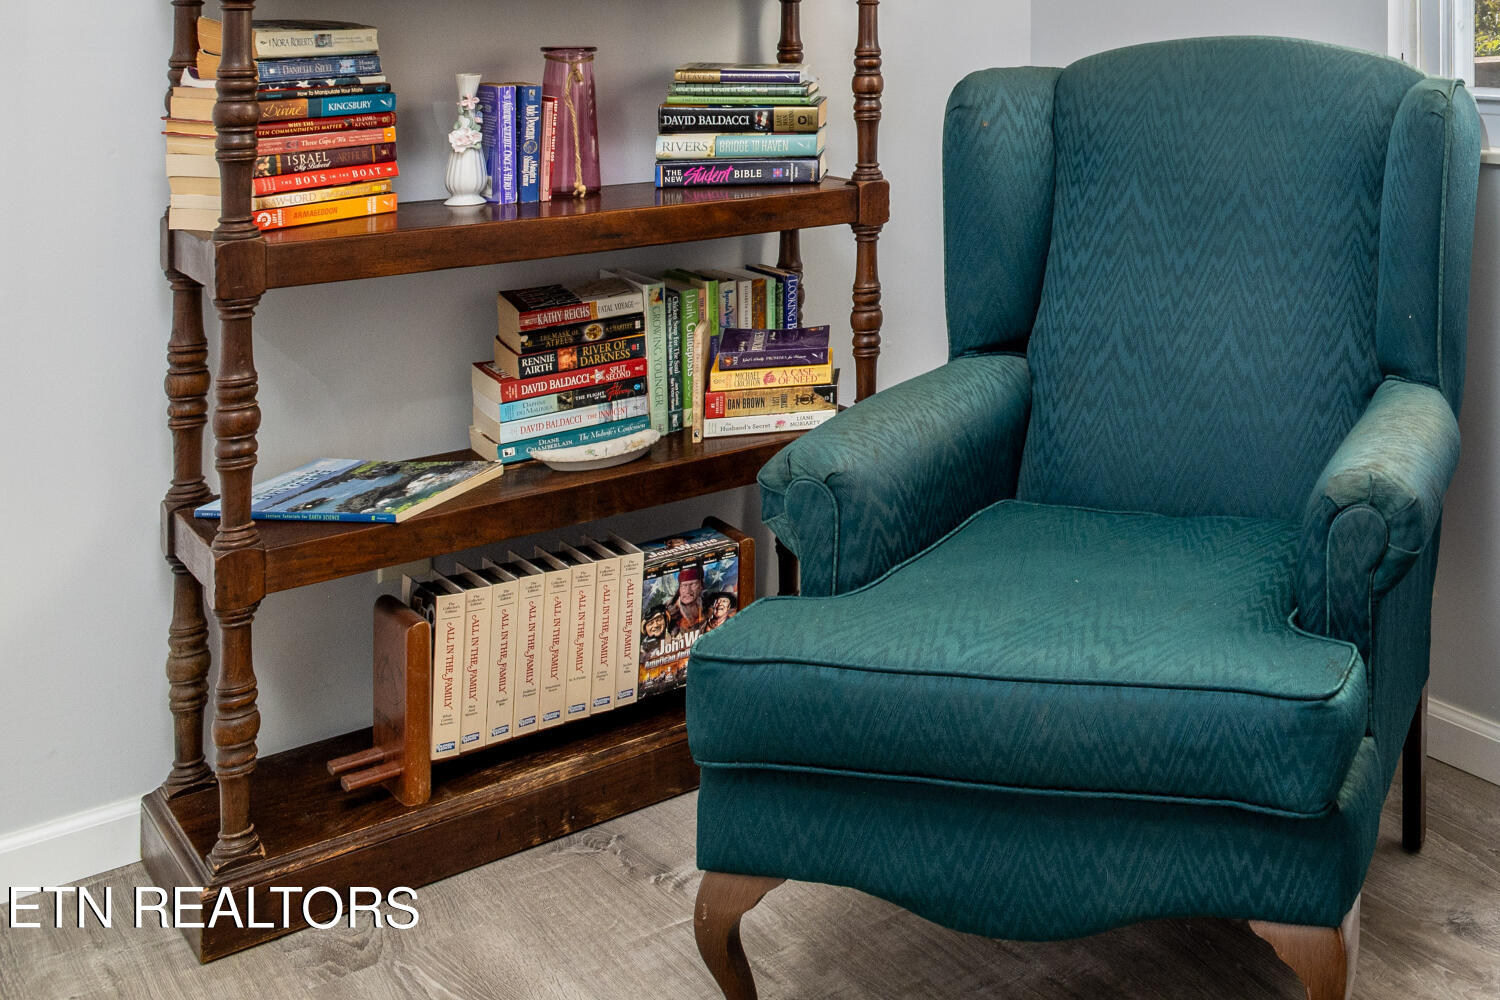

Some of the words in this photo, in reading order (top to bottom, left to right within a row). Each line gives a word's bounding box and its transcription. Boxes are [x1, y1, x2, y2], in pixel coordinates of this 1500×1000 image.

[272, 38, 289, 48] NORA
[290, 37, 314, 47] ROBERTS
[282, 64, 312, 75] DANIELLE
[314, 89, 340, 97] Manipulate
[262, 103, 304, 118] Divine
[328, 100, 372, 112] KINGSBURY
[663, 116, 696, 125] DAVID
[698, 115, 750, 126] BALDACCI
[271, 126, 320, 135] COMMANDMENTS
[318, 138, 332, 146] Cups
[662, 141, 708, 152] RIVERS
[719, 140, 749, 152] BRIDGE
[751, 140, 760, 152] TO
[761, 140, 789, 152] HAVEN
[287, 152, 330, 166] ISRAEL
[295, 174, 328, 186] BOYS
[352, 166, 382, 178] BOAT
[683, 165, 735, 186] Student
[734, 169, 762, 179] BIBLE
[293, 207, 338, 220] ARMAGEDDON
[598, 303, 614, 313] FATAL
[614, 300, 634, 311] VOYAGE
[788, 278, 798, 324] LOOKING
[536, 310, 562, 325] KATHY
[564, 306, 590, 321] REICHS
[582, 344, 611, 356] RIVER
[613, 340, 627, 350] OF
[522, 353, 556, 368] RENNIE
[580, 349, 632, 367] DARKNESS
[525, 363, 553, 376] AIRTH
[605, 370, 631, 382] SECOND
[609, 364, 627, 374] SPLIT
[734, 371, 760, 381] MICHAEL
[790, 368, 814, 376] CASE
[521, 383, 548, 396] DAVID
[549, 374, 590, 390] BALDACCI
[653, 356, 664, 408] YOUNGER
[778, 376, 792, 385] OF
[792, 374, 818, 384] NEED
[586, 390, 606, 399] FLIGHT
[727, 398, 740, 410] DAN
[742, 397, 766, 409] BROWN
[520, 422, 544, 435] DAVID
[546, 415, 582, 428] BALDACCI
[598, 406, 628, 419] INNOCENT
[720, 424, 751, 432] Husband's
[752, 422, 770, 430] Secret
[578, 433, 590, 442] The
[618, 422, 646, 434] Confession
[538, 437, 560, 446] DIANE
[648, 547, 679, 559] John
[602, 584, 610, 604] ALL
[626, 578, 634, 598] ALL
[554, 596, 562, 617] ALL
[578, 590, 586, 610] ALL
[626, 600, 634, 608] IN
[528, 600, 537, 622] ALL
[578, 612, 586, 621] IN
[602, 606, 610, 616] IN
[472, 614, 480, 638] ALL
[528, 622, 536, 630] IN
[553, 618, 560, 627] IN
[602, 616, 610, 634] THE
[446, 622, 455, 644] ALL
[500, 631, 508, 642] IN
[552, 628, 560, 646] THE
[578, 622, 586, 640] THE
[472, 638, 480, 648] IN
[528, 632, 536, 652] THE
[622, 625, 632, 660] FAMILY
[658, 638, 684, 656] John
[446, 645, 454, 655] IN
[470, 648, 478, 666] THE
[500, 643, 508, 660] THE
[574, 638, 584, 674] FAMILY
[600, 632, 609, 668] FAMILY
[446, 656, 454, 675] THE
[524, 650, 534, 686] FAMILY
[549, 645, 560, 681] FAMILY
[466, 665, 478, 702] FAMILY
[496, 659, 508, 694] FAMILY
[442, 674, 454, 710] FAMILY
